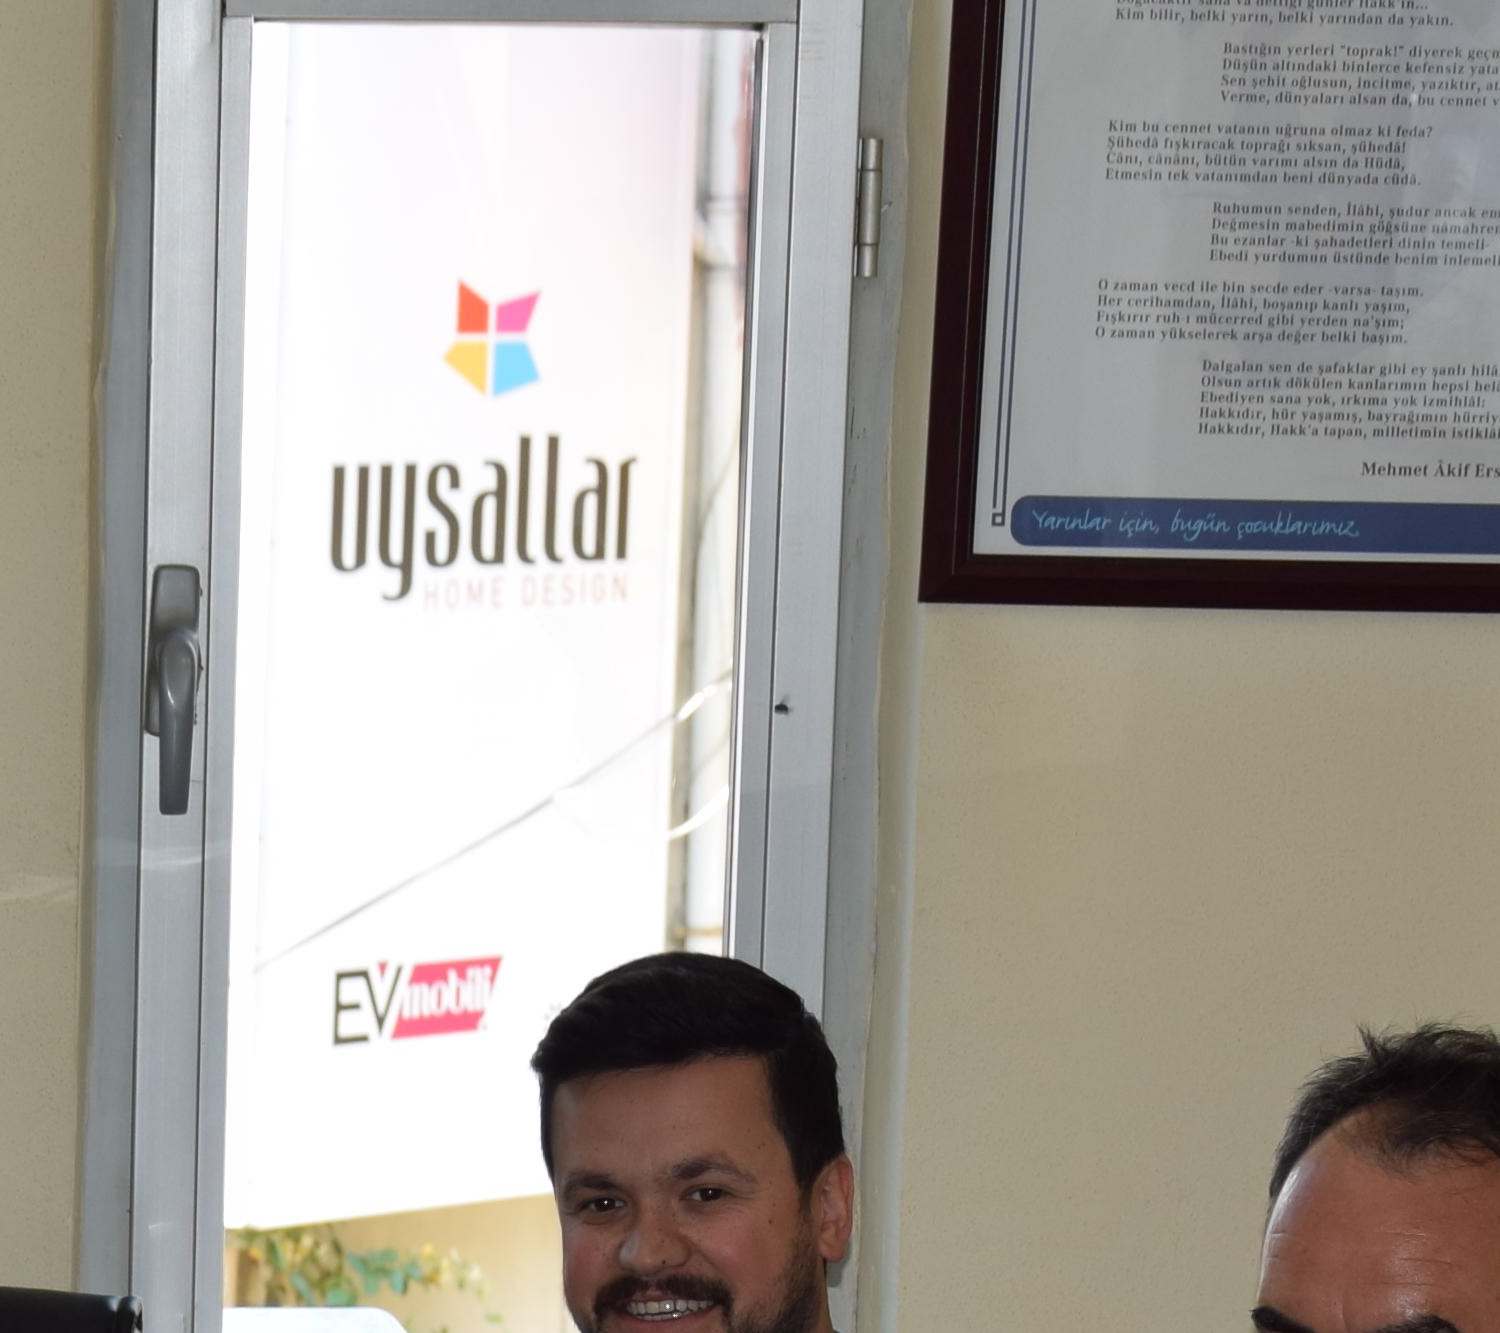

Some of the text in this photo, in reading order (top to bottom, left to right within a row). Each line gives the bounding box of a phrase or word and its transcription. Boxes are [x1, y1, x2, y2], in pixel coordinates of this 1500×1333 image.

[1115, 10, 1453, 28] Kim bilir, belki yarın, belki yarından da yakın.
[1223, 43, 1281, 58] Bastığın
[1287, 44, 1335, 59] yerleri
[1407, 46, 1463, 61] diyerek
[1221, 59, 1267, 74] Düşün
[1271, 60, 1339, 72] altındaki
[1341, 61, 1401, 73] binlerce
[1404, 62, 1465, 74] kefensiz
[1220, 76, 1481, 93] Sen şehit oğlusun, incitme, yazıktır,
[1221, 92, 1270, 105] Verme,
[1274, 92, 1344, 107] dünyaları
[1347, 93, 1387, 105] alsan
[1391, 94, 1413, 107] da,
[1416, 94, 1435, 105] bu
[1439, 95, 1486, 106] cennet
[1108, 121, 1137, 132] Kim
[1142, 122, 1160, 133] bu
[1164, 122, 1211, 134] cennet
[1217, 123, 1270, 134] vatanın
[1275, 124, 1326, 138] uğruna
[1330, 125, 1373, 136] olmaz
[1377, 126, 1394, 136] ki
[1163, 138, 1235, 153] fışkıracak
[1240, 139, 1291, 154] toprağı
[1295, 140, 1346, 153] sıksan,
[1204, 155, 1246, 166] bütün
[1251, 159, 1298, 167] varımı
[1302, 156, 1338, 167] alsın
[1342, 157, 1359, 168] da
[1105, 169, 1163, 181] Etmesin
[1167, 170, 1189, 181] tek
[1194, 171, 1278, 182] vatanımdan
[1282, 172, 1314, 183] beni
[1317, 172, 1379, 187] dünyada
[1212, 203, 1477, 220] Ruhumun senden, İlâhi, şudur ancak
[1097, 280, 1108, 291] O
[1112, 283, 1158, 291] zaman
[1163, 281, 1197, 292] vecd
[1196, 282, 1218, 292] ile
[1222, 282, 1245, 293] bin
[1249, 282, 1289, 294] secde
[1292, 283, 1323, 294] eder
[1380, 285, 1423, 299] taşım.
[1096, 312, 1152, 326] Fışkırır
[1195, 313, 1263, 325] mücerred
[1267, 314, 1294, 328] gibi
[1300, 315, 1348, 329] yerden
[1094, 327, 1407, 346] O zaman yükselerek arşa değer belki başım.
[1201, 361, 1263, 375] Dalgalan
[1268, 365, 1292, 373] sen
[1296, 362, 1313, 373] de
[1317, 363, 1376, 377] şafaklar
[1379, 363, 1406, 377] gibi
[1410, 367, 1427, 378] ey
[1431, 364, 1466, 378] şanlı
[1200, 376, 1244, 387] Olsun
[1243, 377, 1281, 388] artık
[1285, 378, 1343, 389] dökülen
[1347, 379, 1427, 390] kanlarımın
[1431, 380, 1469, 394] hepsi
[1200, 392, 1265, 407] Ebediyen
[1269, 396, 1302, 404] sana
[1307, 394, 1336, 408] yok,
[1340, 394, 1388, 405] ırkıma
[1393, 395, 1418, 409] yok
[1199, 408, 1266, 421] Hakkıdır,
[1270, 409, 1296, 420] hür
[1301, 412, 1362, 424] yaşamış,
[1367, 410, 1448, 425] bayrağımın
[1198, 423, 1265, 437] Hakkıdır,
[1270, 424, 1319, 436] Hakk'a
[1323, 425, 1367, 439] tapan,
[1372, 426, 1447, 438] milletimin
[1361, 461, 1428, 476] Mehmet
[1433, 460, 1469, 477] Âkif
[330, 433, 638, 601] uysallar
[1031, 508, 1111, 531] Yarınlar
[1119, 511, 1160, 536] için,
[1170, 509, 1231, 541] bugün
[424, 572, 630, 610] HOME DESIGN
